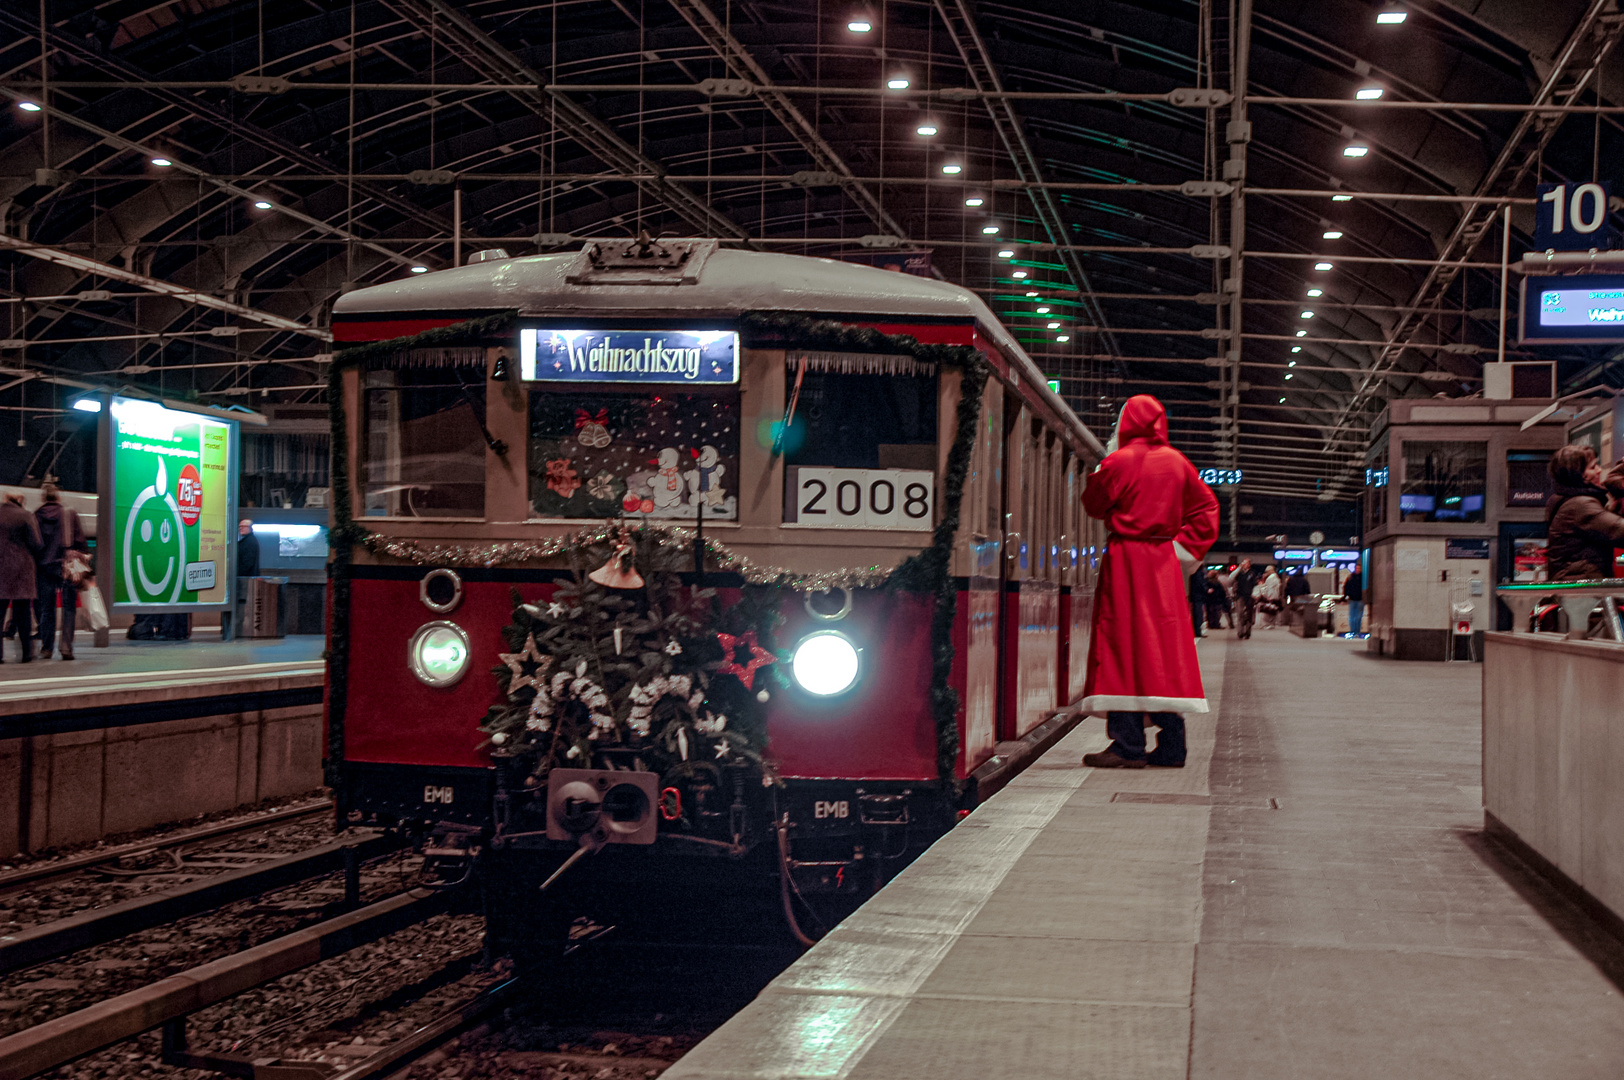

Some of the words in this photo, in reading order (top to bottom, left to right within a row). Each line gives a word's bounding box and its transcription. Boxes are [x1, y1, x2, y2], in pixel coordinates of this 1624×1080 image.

[1542, 182, 1606, 234] 10
[1542, 292, 1561, 306] S3
[565, 335, 701, 379] Weihnachtszug
[801, 478, 929, 519] 2008
[1513, 491, 1544, 500] Aufsicht
[188, 567, 213, 583] eprimo
[254, 598, 262, 631] Abfall
[423, 785, 454, 803] EMB
[814, 800, 849, 819] EMB
